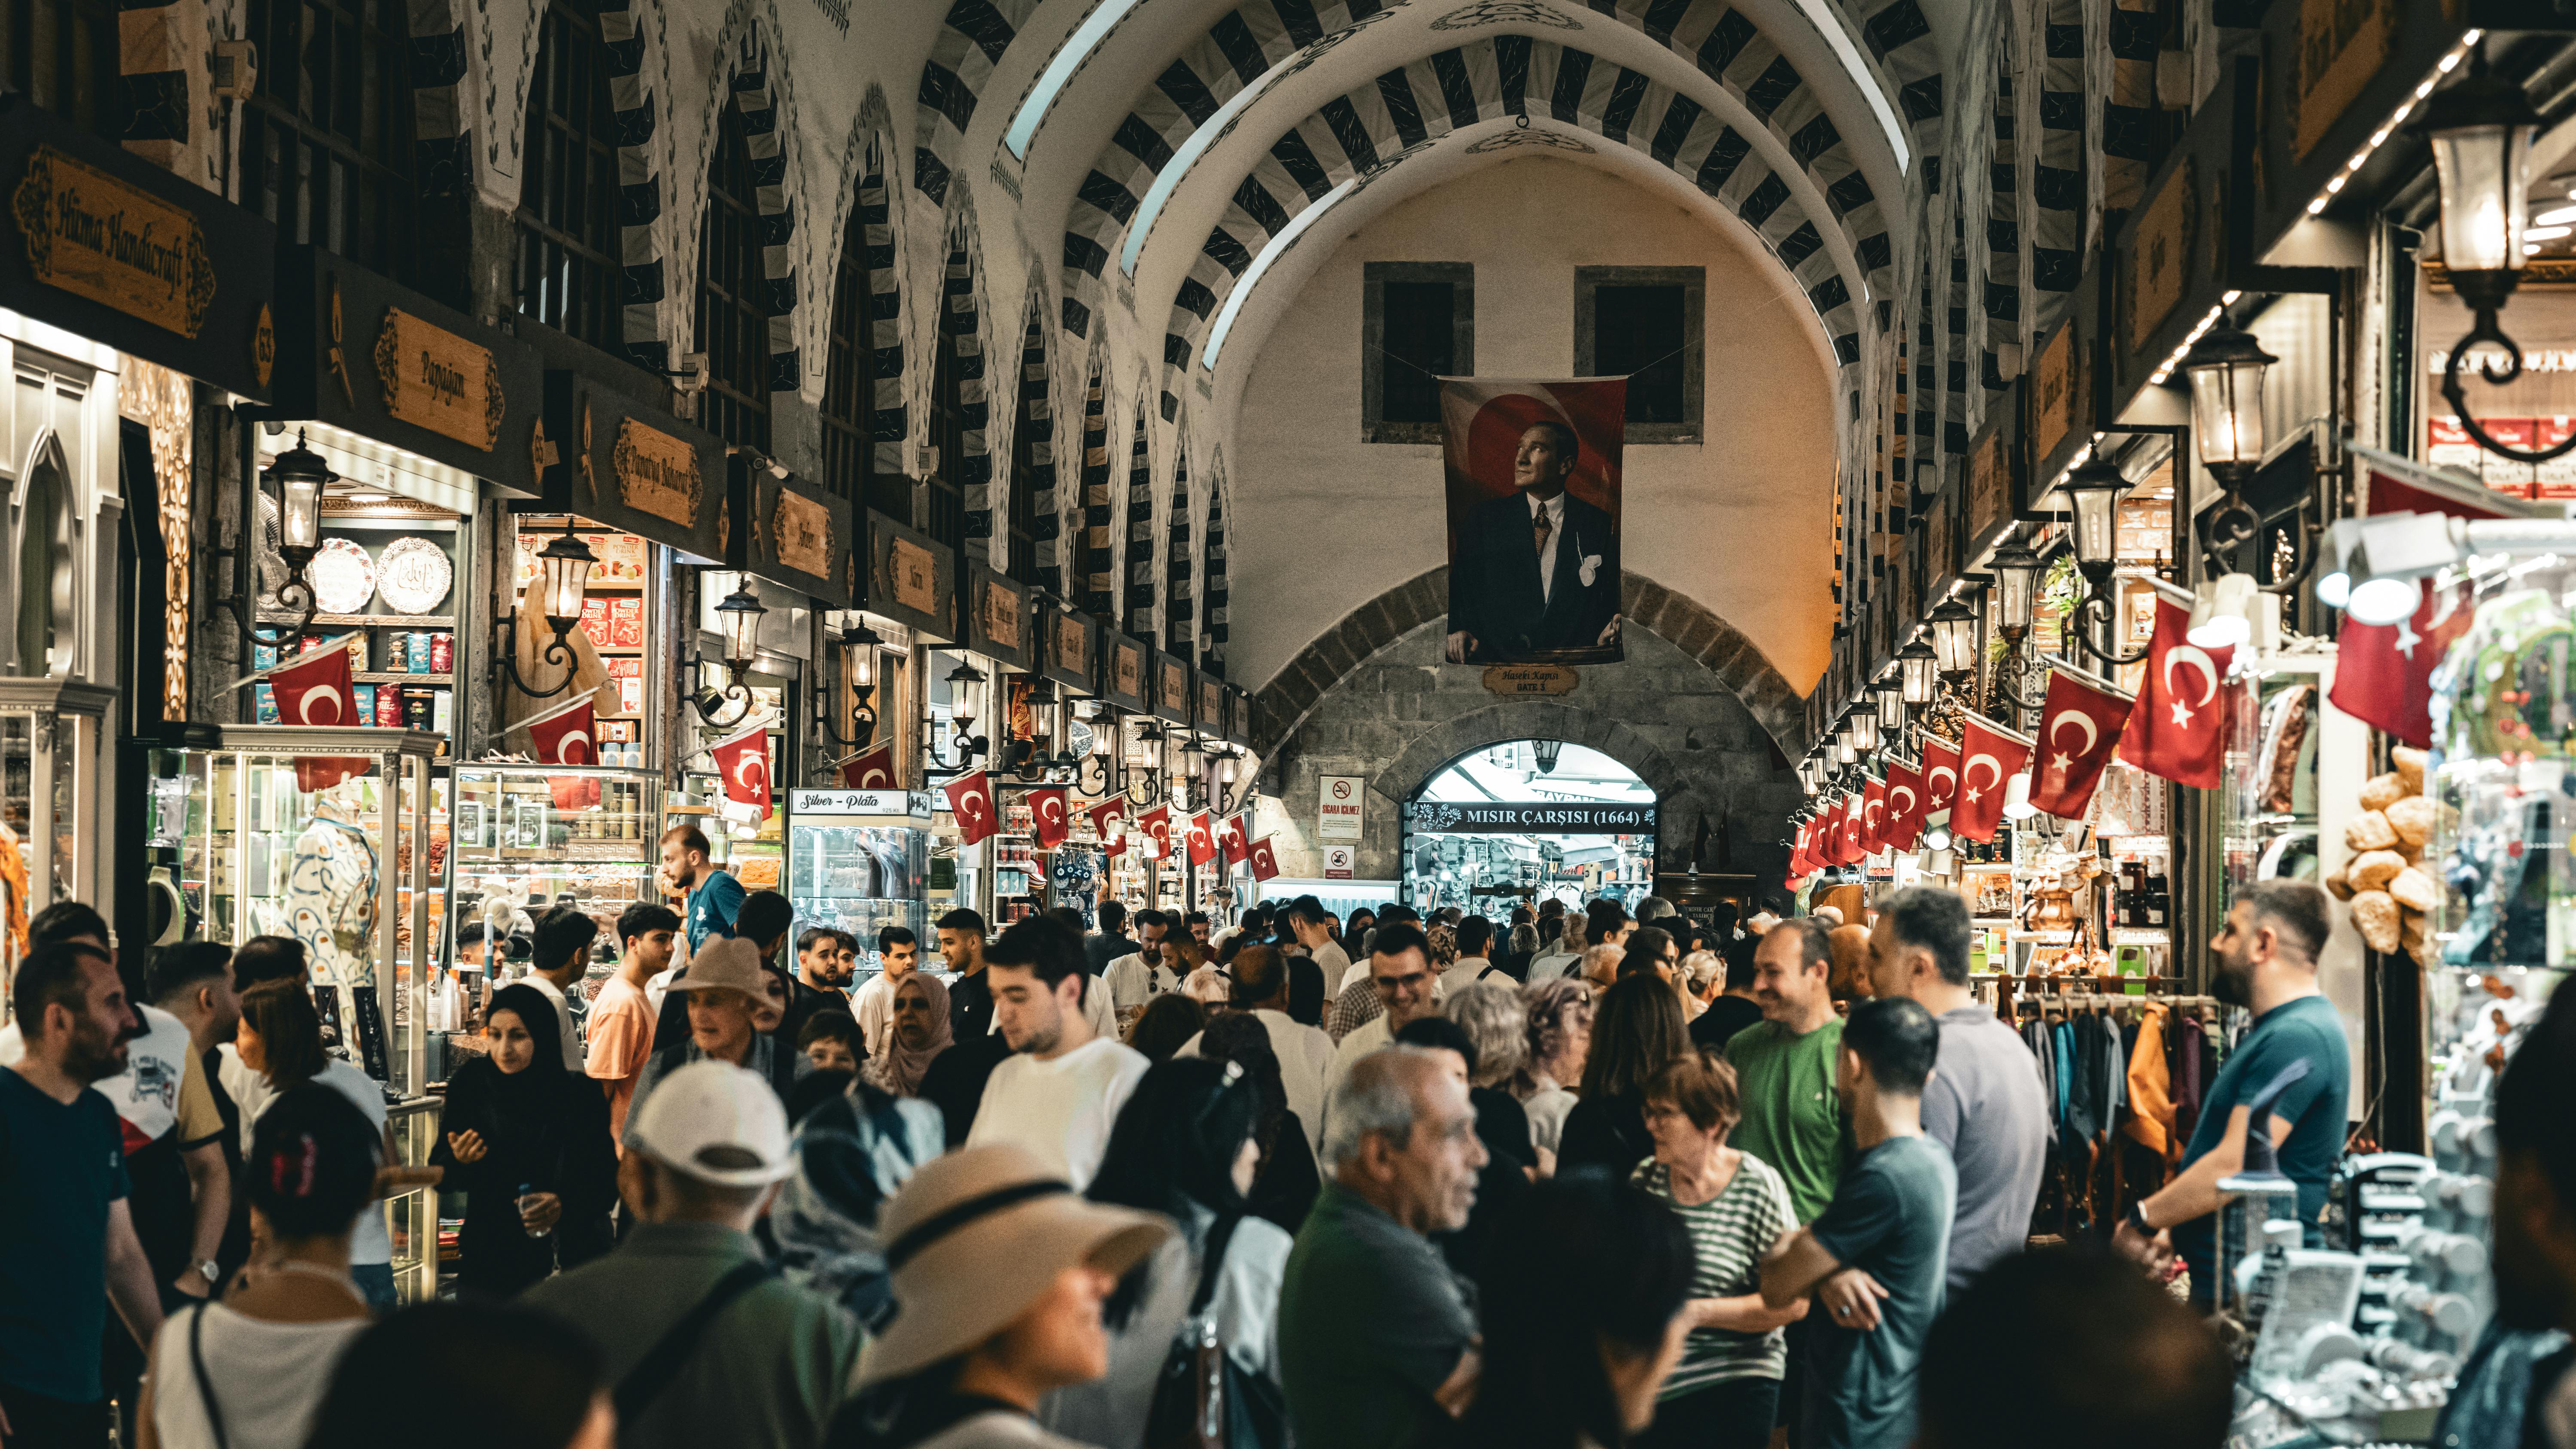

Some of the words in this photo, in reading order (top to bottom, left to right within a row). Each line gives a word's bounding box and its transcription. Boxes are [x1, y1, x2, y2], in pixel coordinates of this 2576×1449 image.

[1502, 670, 1530, 680] Haseki
[1531, 671, 1558, 682] Kapısı
[378, 701, 395, 711] filiz
[800, 794, 833, 809] Silver
[846, 795, 879, 809] Plata
[1322, 803, 1340, 814] SİGARA
[1341, 804, 1360, 815] İÇİLMEZ
[1467, 811, 1517, 823] MISIR
[1522, 811, 1589, 826] ÇARŞISI
[1594, 811, 1640, 826] (1664)
